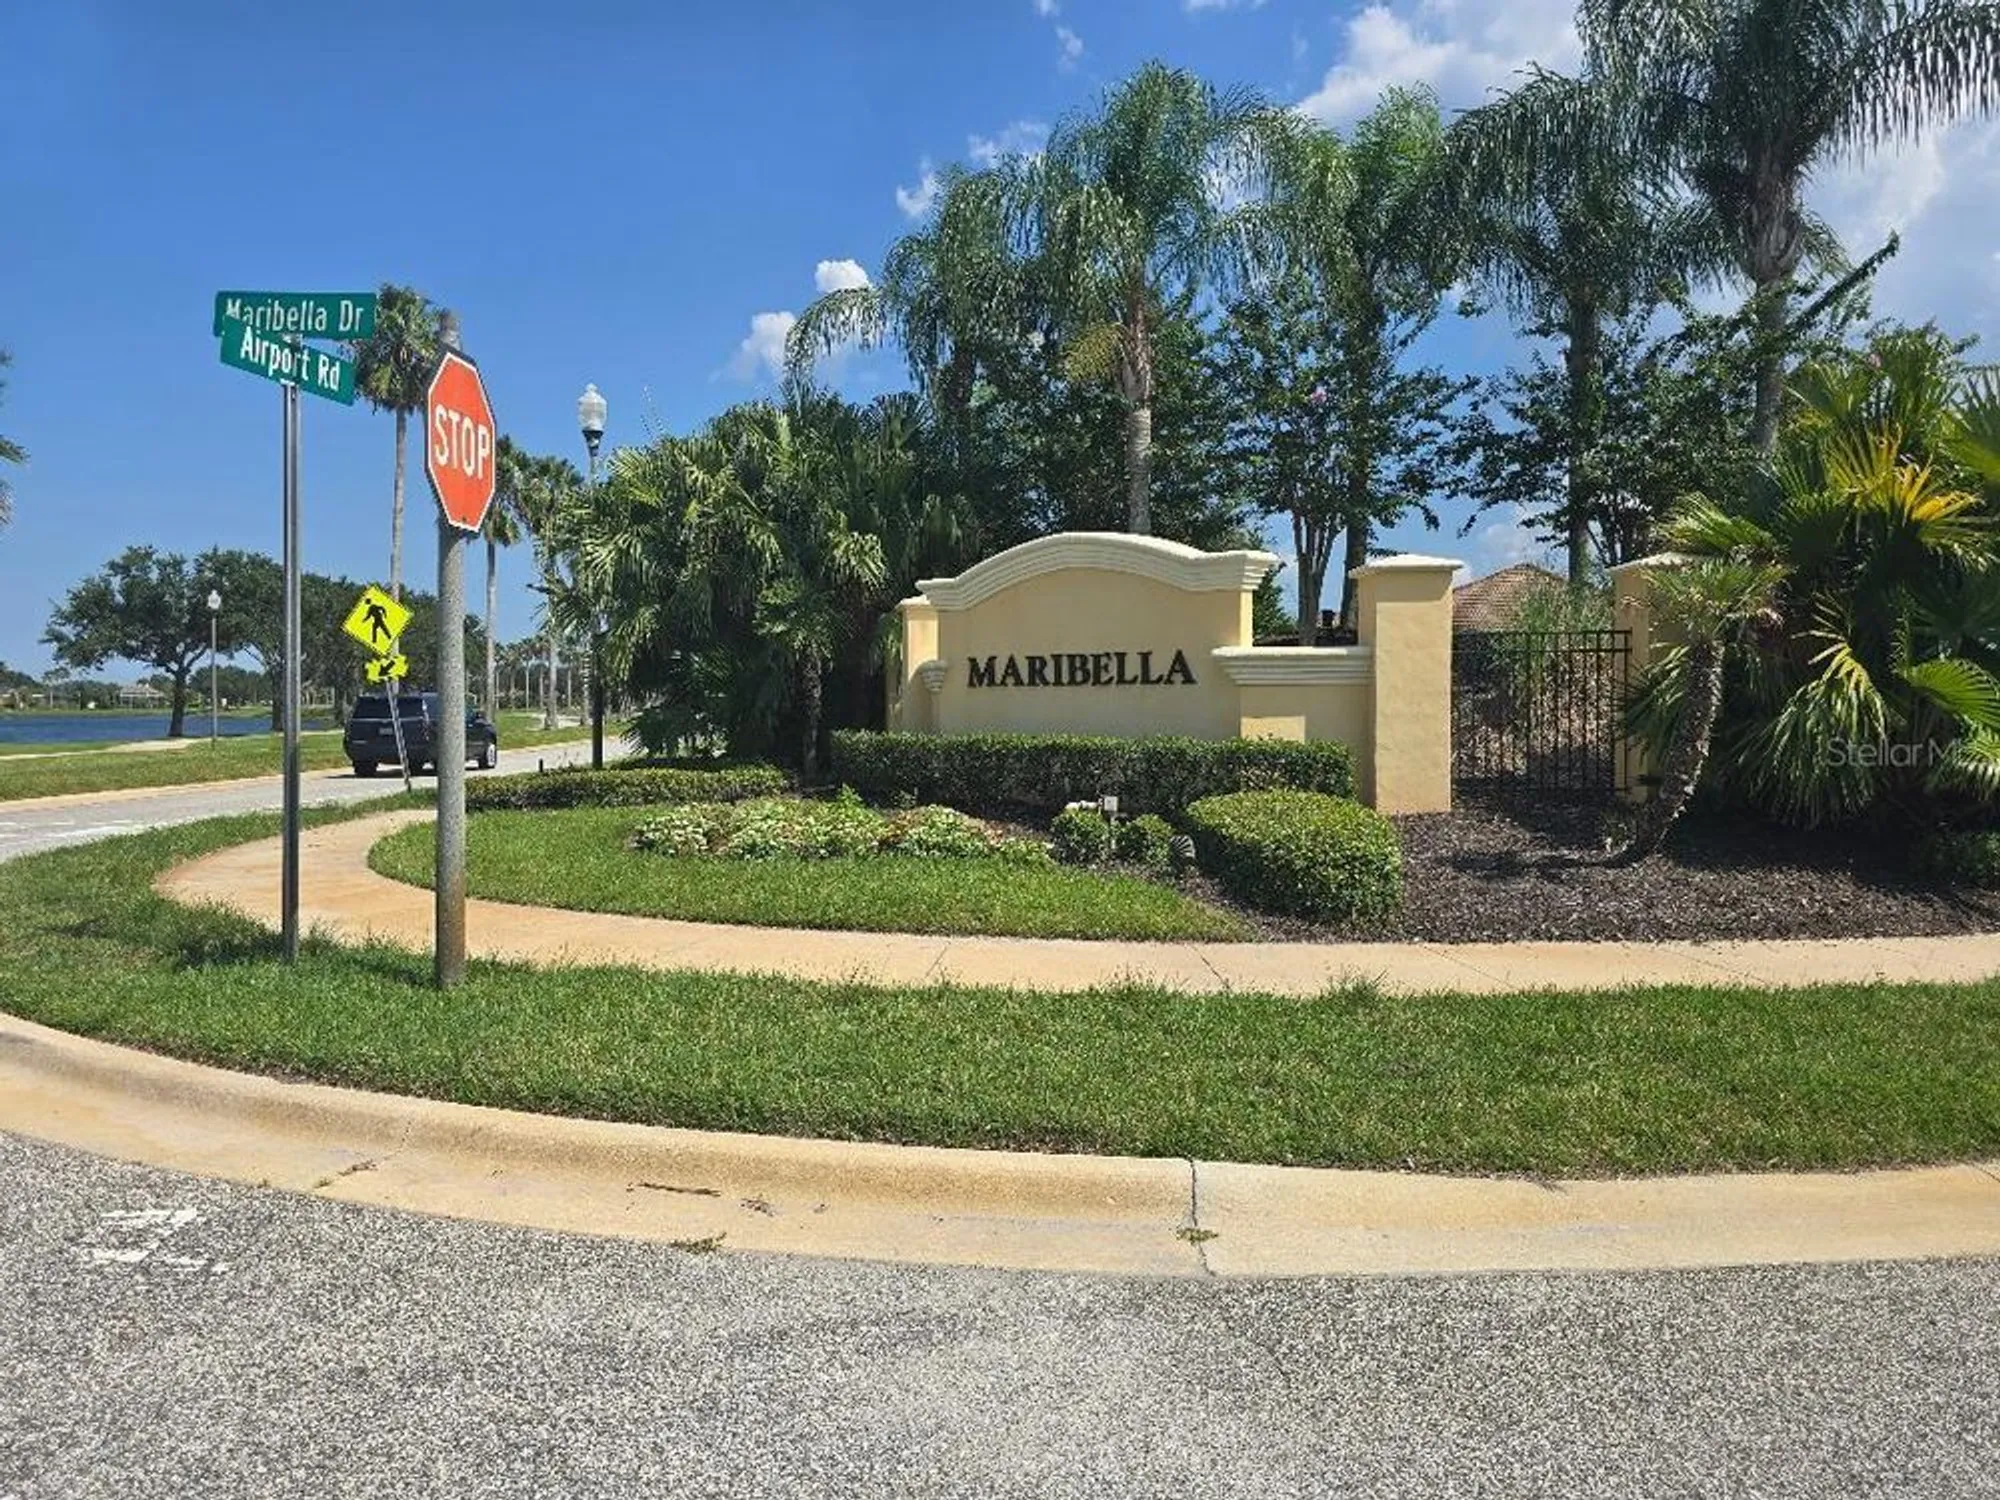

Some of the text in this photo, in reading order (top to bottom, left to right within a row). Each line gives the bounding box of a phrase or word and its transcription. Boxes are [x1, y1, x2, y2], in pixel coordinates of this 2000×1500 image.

[226, 298, 364, 332] Maribella Dr
[240, 326, 340, 391] Airport Rd
[434, 403, 490, 480] STOP
[967, 650, 1197, 688] MARIBELLA
